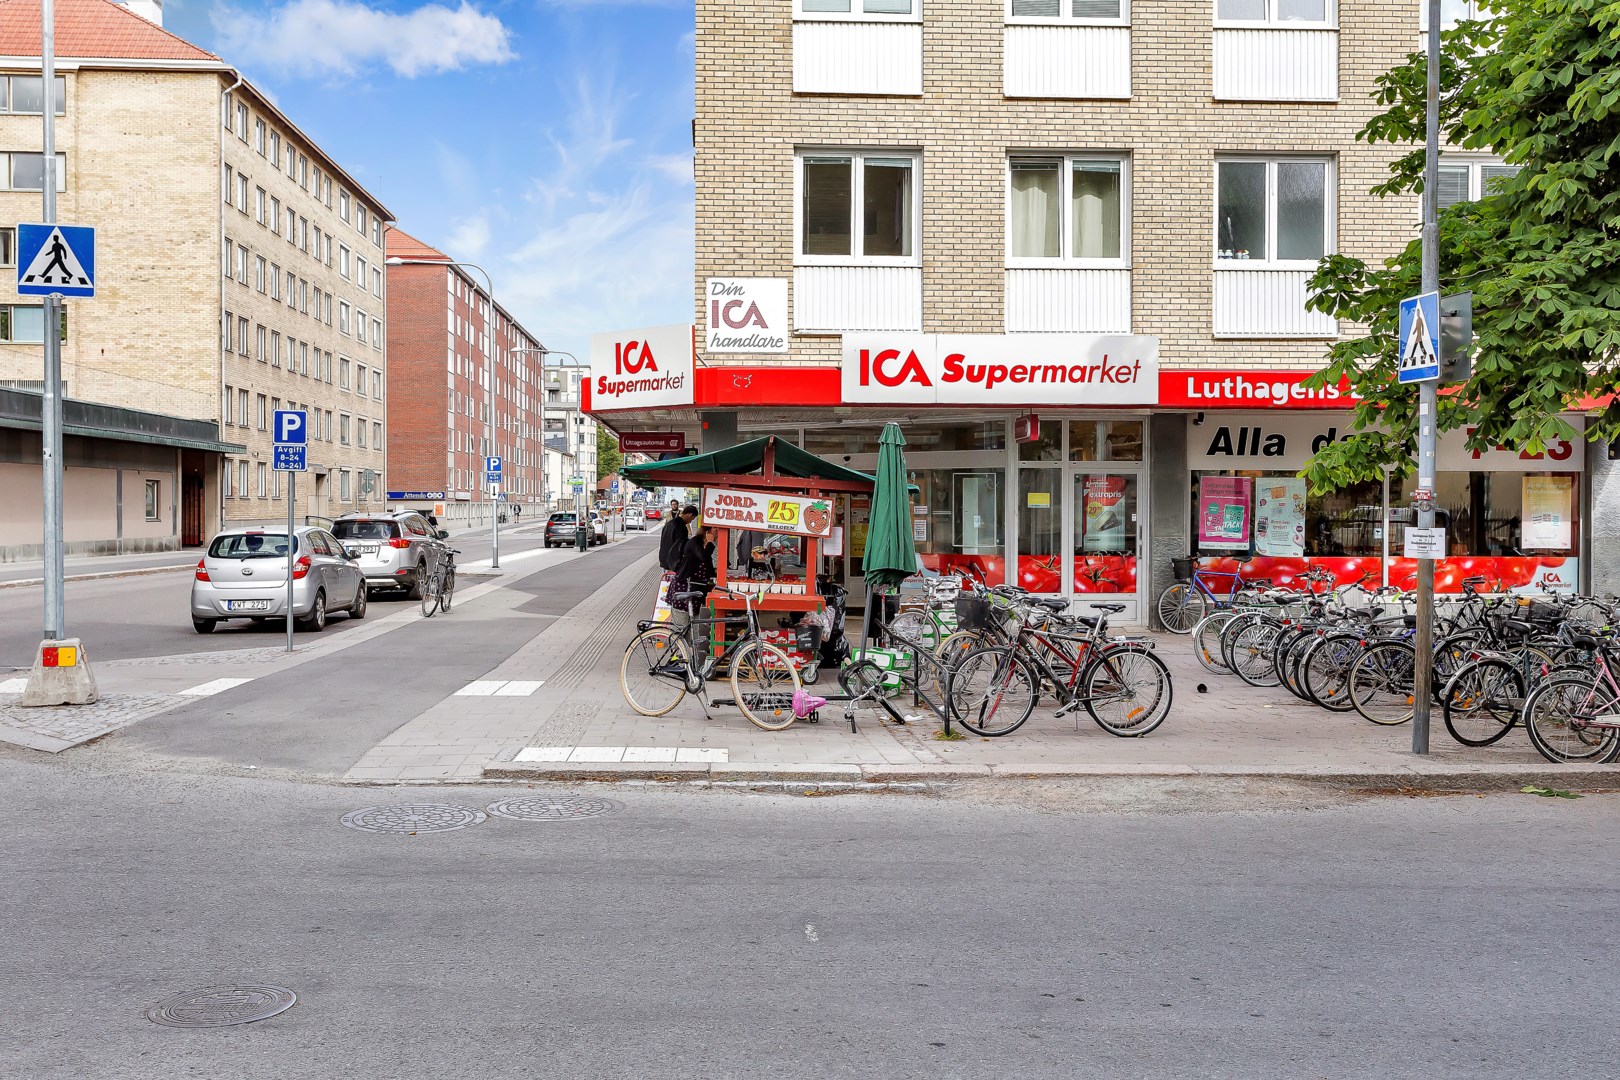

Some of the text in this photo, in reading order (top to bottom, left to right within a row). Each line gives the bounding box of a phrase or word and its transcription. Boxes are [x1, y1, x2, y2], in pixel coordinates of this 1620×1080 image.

[711, 282, 745, 296] Din
[712, 299, 769, 329] ICA
[710, 333, 784, 348] handlare
[615, 340, 658, 375] ICA
[860, 349, 1141, 389] ICA Supermarket
[597, 370, 684, 398] Supermarket
[1187, 376, 1340, 405] Luthagens
[282, 413, 301, 441] P
[1206, 427, 1286, 456] Alla
[490, 458, 499, 471] P
[714, 494, 757, 508] JORD-
[1090, 491, 1121, 499] extrapris
[705, 507, 764, 523] GUBBAR
[1543, 572, 1561, 582] ICA
